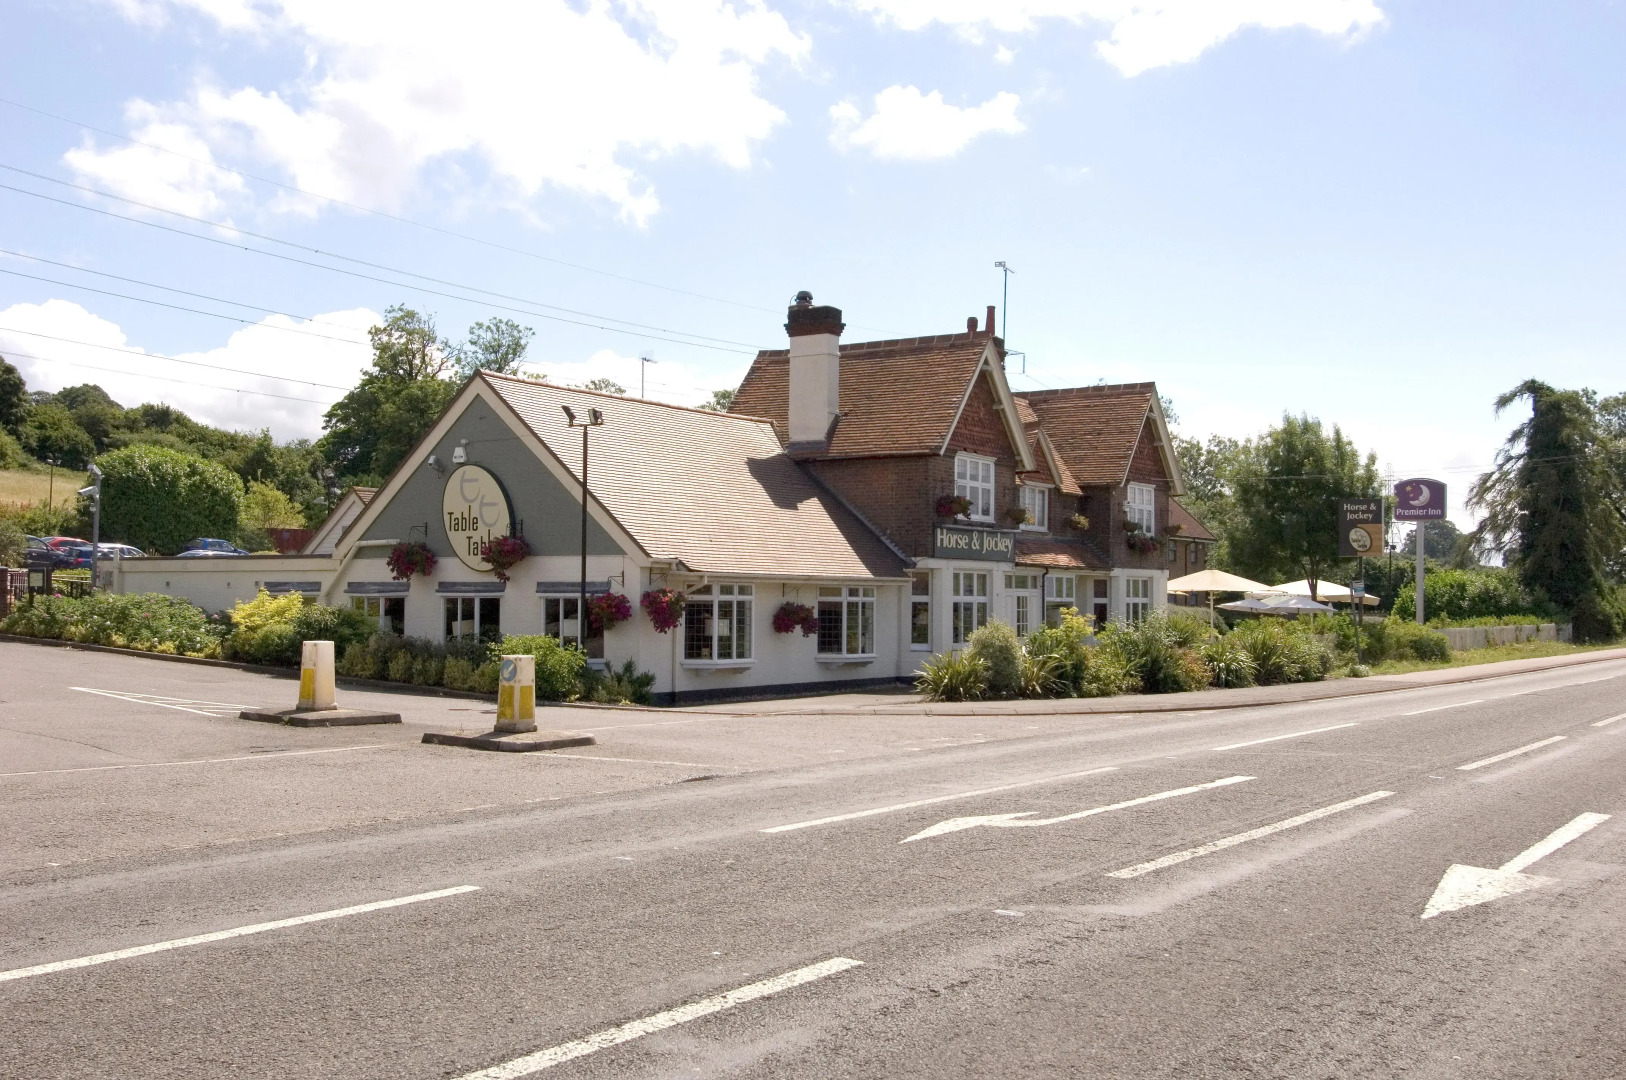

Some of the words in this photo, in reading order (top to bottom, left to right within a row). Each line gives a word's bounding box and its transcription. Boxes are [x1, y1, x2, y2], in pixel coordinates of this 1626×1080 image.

[1343, 503, 1368, 511] Horse
[1369, 502, 1377, 511] &
[1396, 508, 1427, 516] Premier
[1428, 508, 1442, 516] Inn
[447, 504, 479, 532] Table
[1346, 511, 1374, 521] Jockey
[466, 529, 493, 556] Tabl
[936, 528, 969, 549] Horse
[971, 531, 981, 550] &
[982, 531, 1014, 559] Jockey
